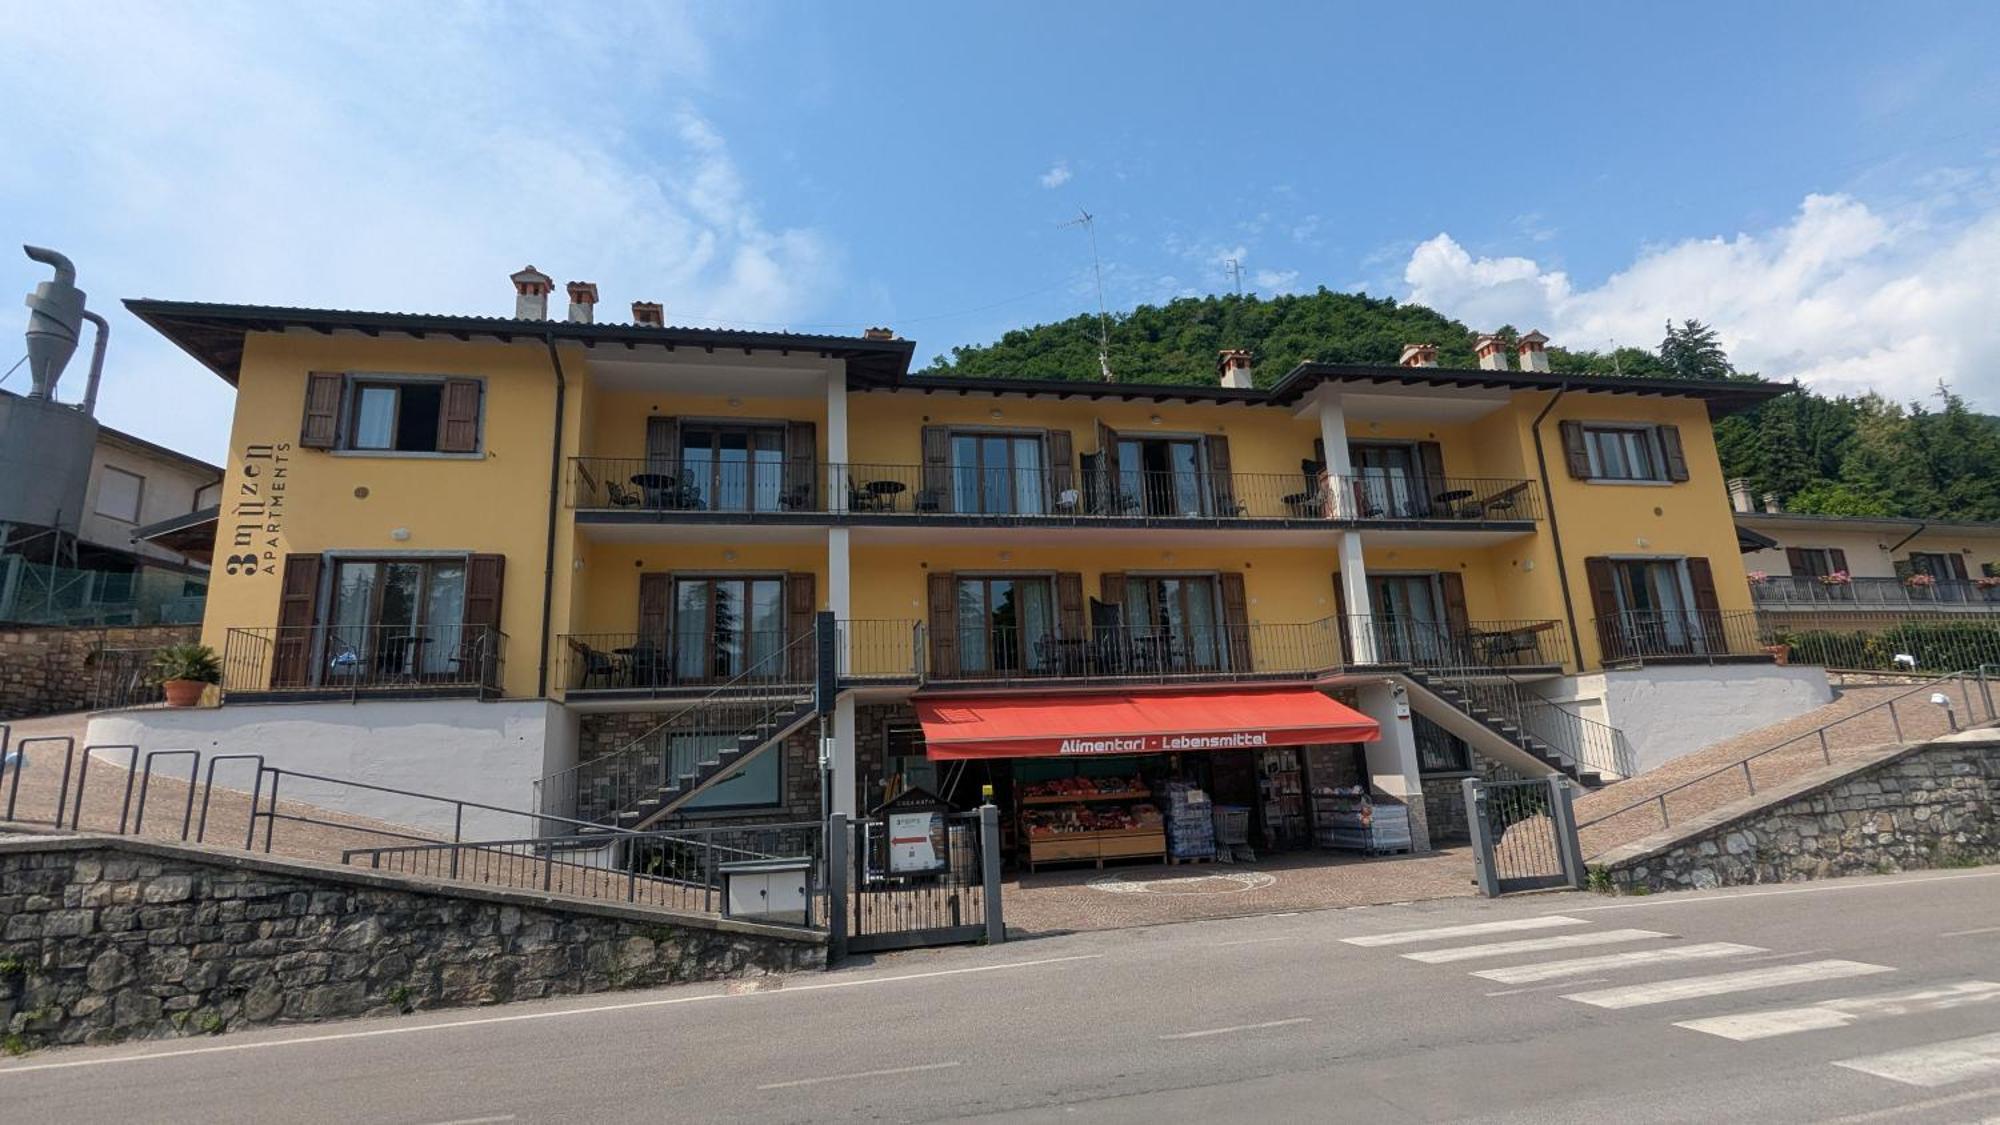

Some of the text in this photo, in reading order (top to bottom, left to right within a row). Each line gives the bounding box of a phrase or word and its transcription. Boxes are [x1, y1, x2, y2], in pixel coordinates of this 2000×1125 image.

[262, 443, 289, 575] APARTMENTS
[227, 554, 258, 576] 3
[1060, 737, 1145, 753] Alimentari
[1162, 732, 1267, 749] Lebensmittel
